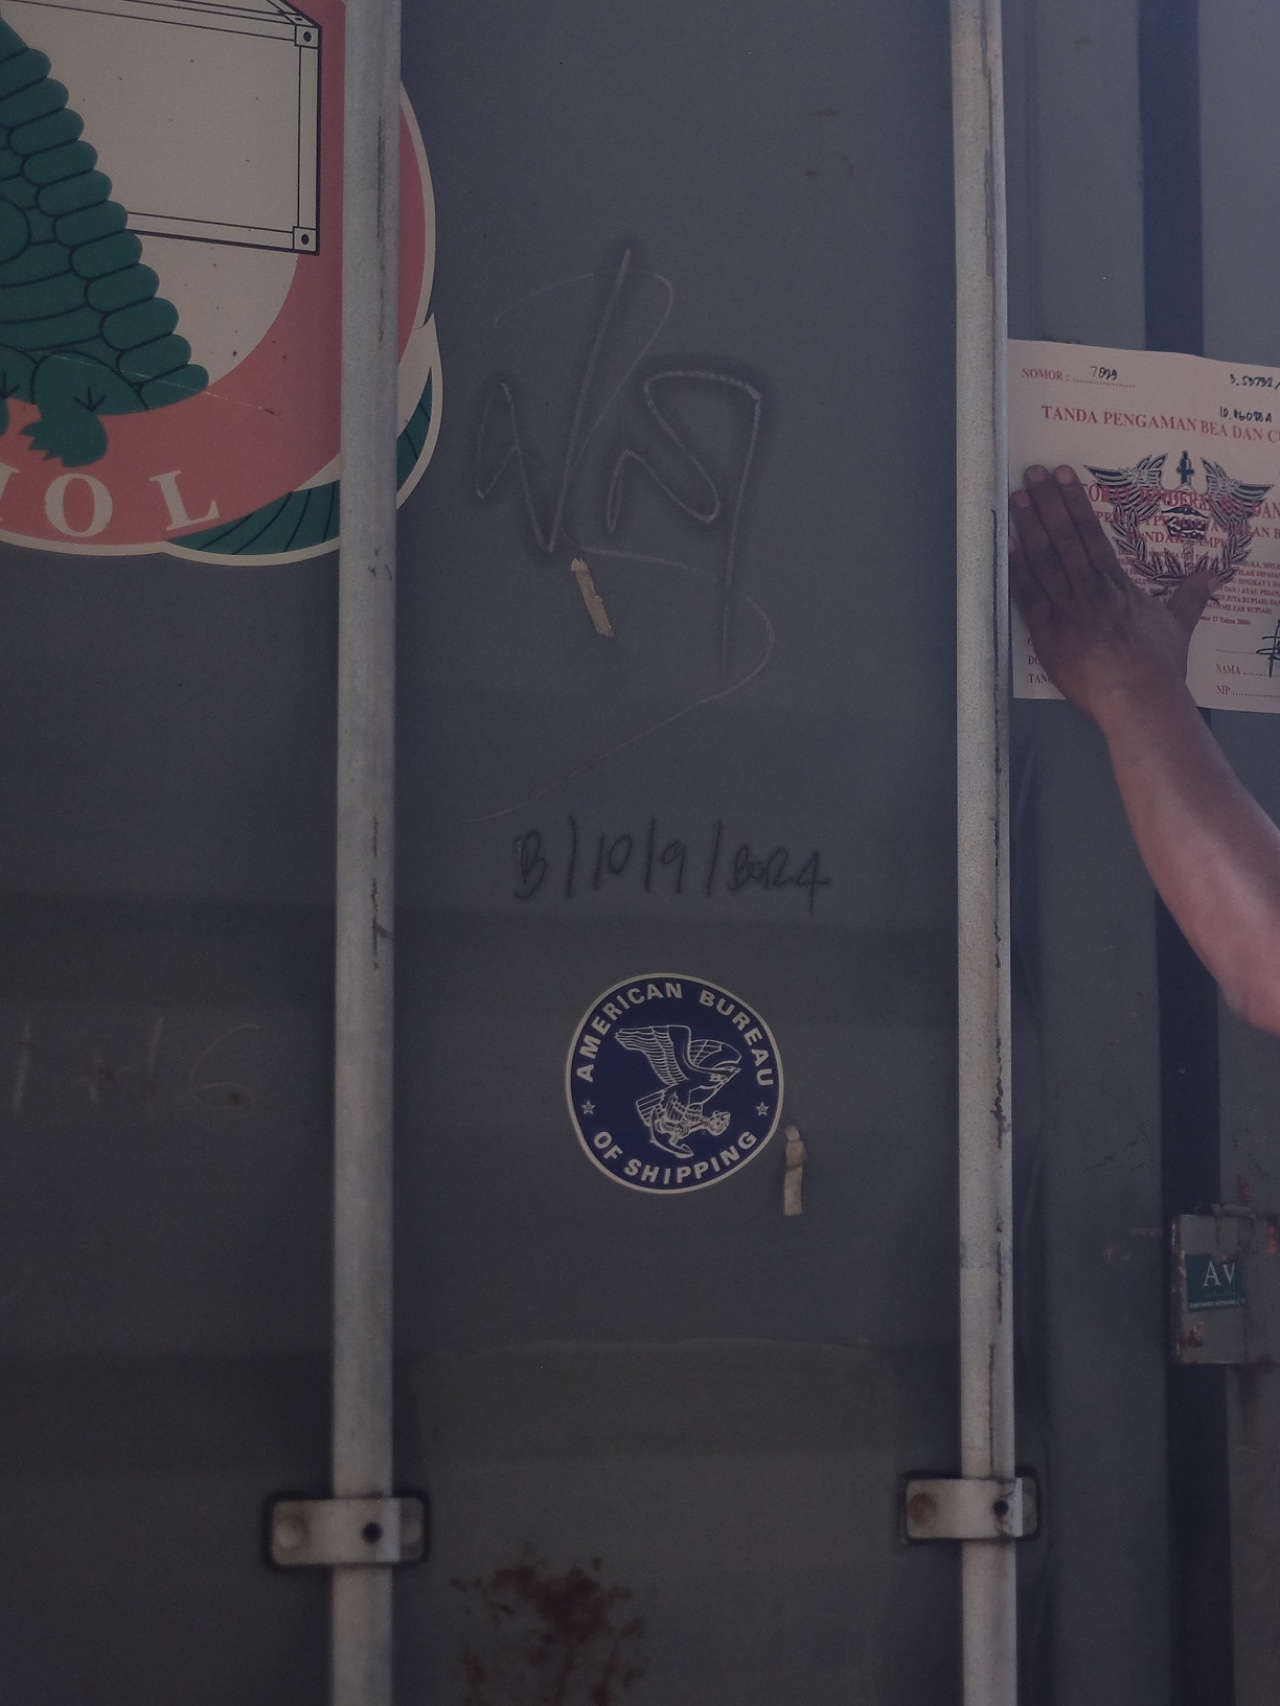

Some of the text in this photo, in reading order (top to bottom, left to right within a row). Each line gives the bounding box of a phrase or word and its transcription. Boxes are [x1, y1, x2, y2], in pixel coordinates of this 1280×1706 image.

[1021, 368, 1064, 382] NOMOR
[1041, 405, 1098, 425] TANDA
[1103, 411, 1197, 433] PENGAMAN
[1200, 420, 1229, 438] BEA
[1232, 425, 1263, 442] DAN
[1216, 664, 1241, 676] NAMA
[1216, 685, 1231, 696] NIP
[575, 981, 775, 1087] AMERICAN BUREAU
[594, 1130, 759, 1185] OF SHIPPING
